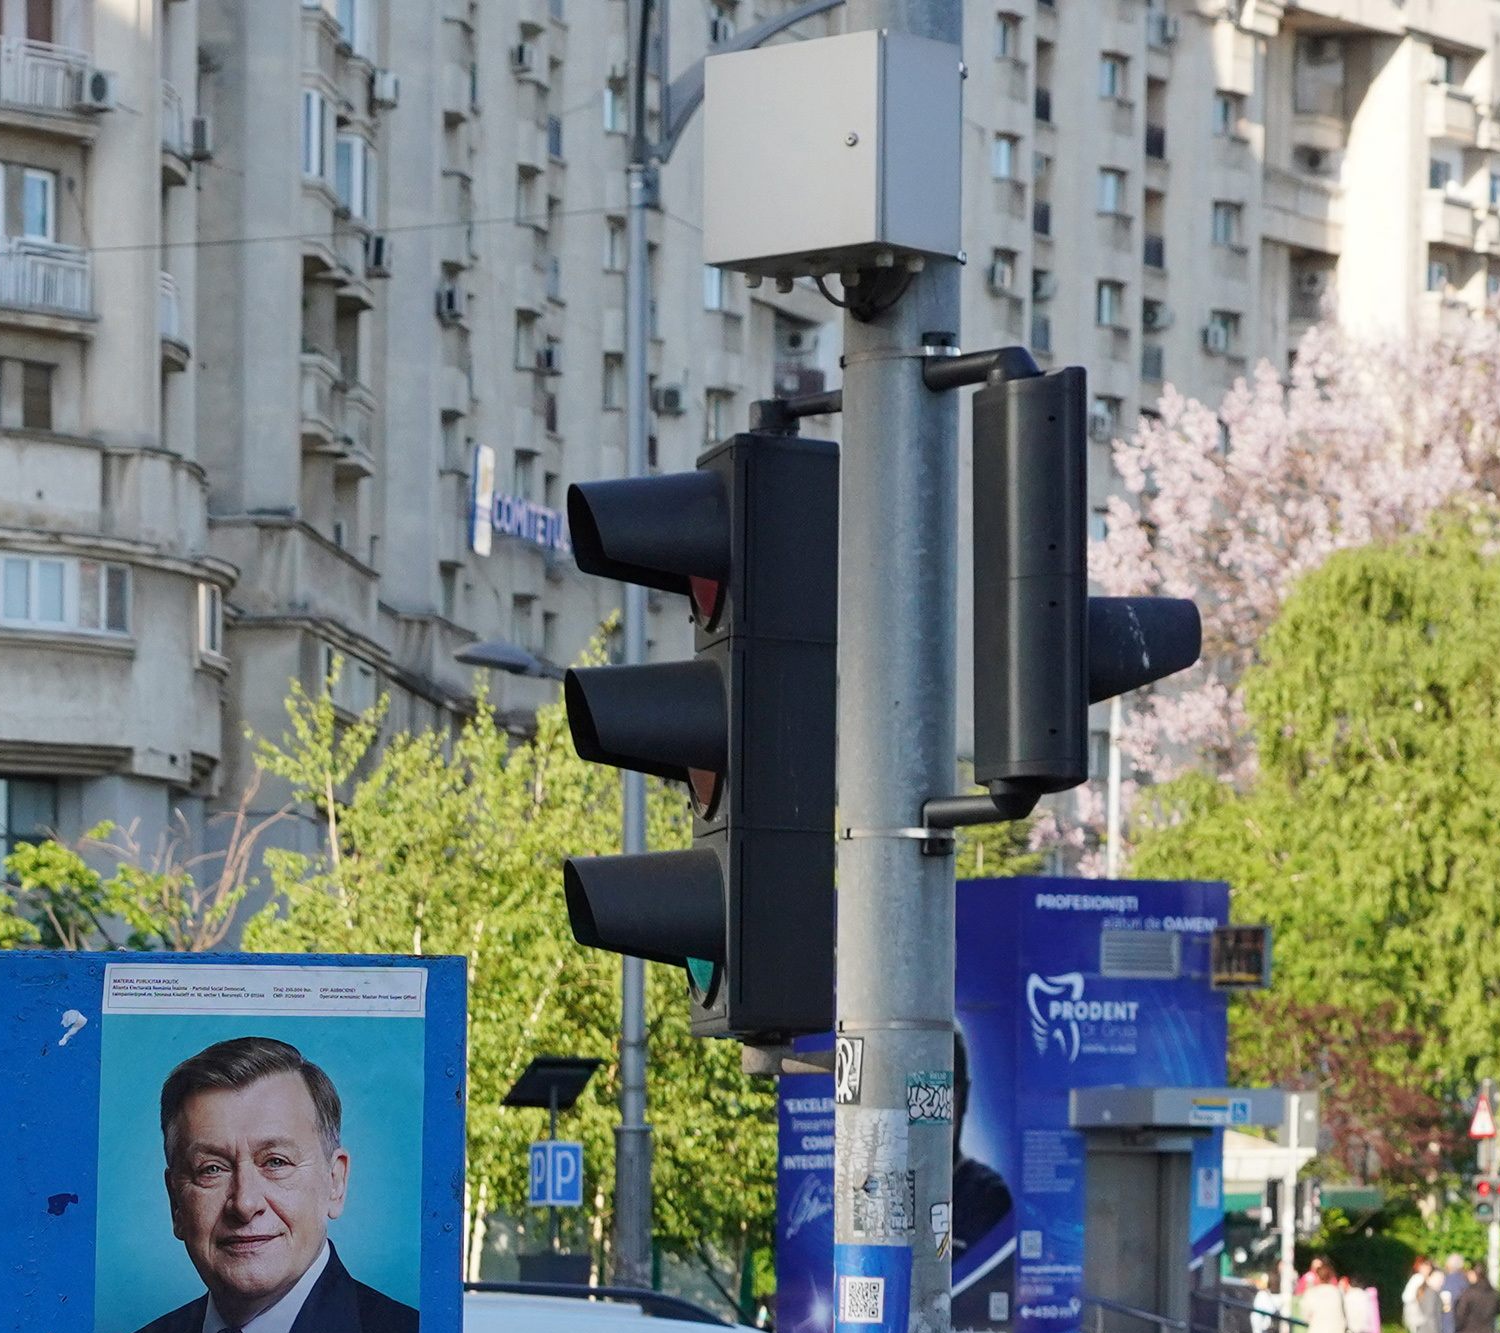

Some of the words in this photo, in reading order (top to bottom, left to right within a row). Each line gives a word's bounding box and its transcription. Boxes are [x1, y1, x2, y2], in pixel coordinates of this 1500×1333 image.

[1049, 1001, 1139, 1020] PRODENT
[533, 1151, 546, 1195] P
[556, 1151, 576, 1196] P
